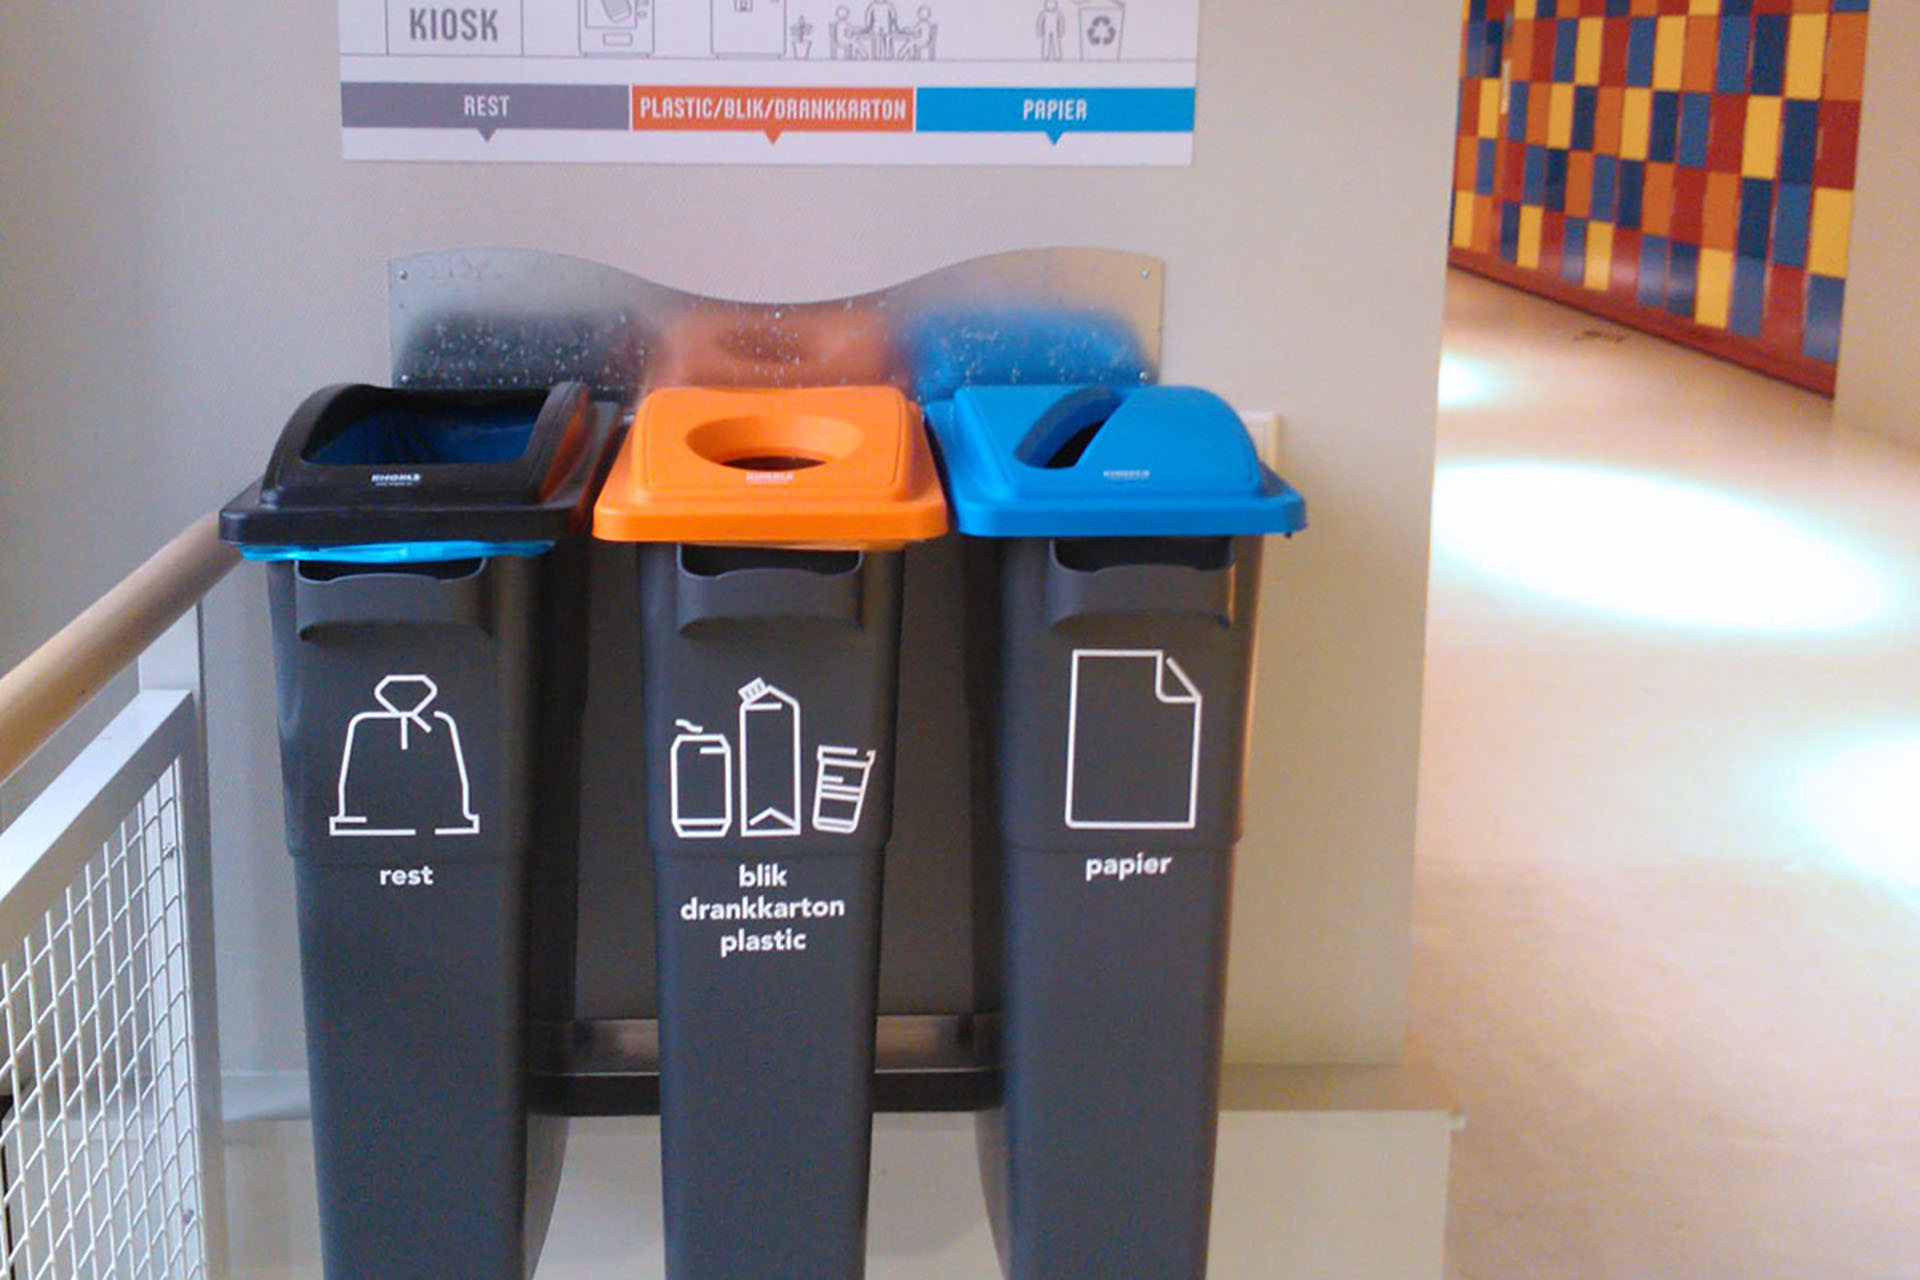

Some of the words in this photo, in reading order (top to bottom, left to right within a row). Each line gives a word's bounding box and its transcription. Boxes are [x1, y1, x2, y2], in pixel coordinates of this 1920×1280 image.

[409, 8, 498, 41] KIOSK
[464, 95, 510, 117] REST
[640, 96, 907, 121] PLASTIC/BLIK/DRANKKARTON
[1023, 98, 1088, 121] PAPIER
[380, 865, 434, 885] rest
[739, 862, 788, 887] blik
[1086, 852, 1173, 881] papier
[680, 895, 845, 920] drankkarton
[720, 928, 807, 958] plastic
